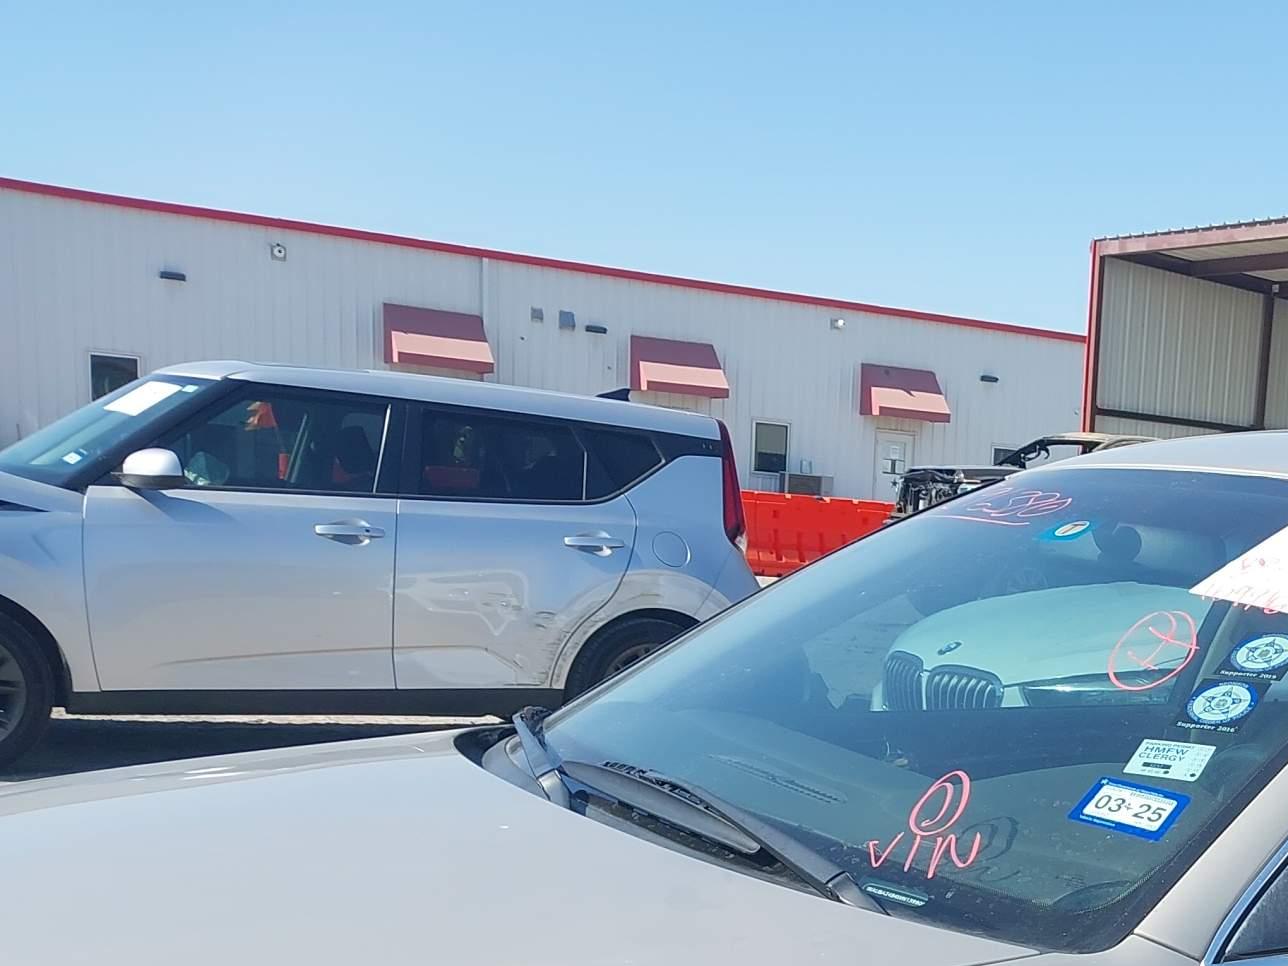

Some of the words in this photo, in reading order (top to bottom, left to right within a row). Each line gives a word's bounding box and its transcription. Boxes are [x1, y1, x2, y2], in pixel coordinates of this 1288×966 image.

[1219, 670, 1258, 679] Supporter
[1176, 720, 1217, 731] Supporter
[1138, 751, 1185, 762] CLERGY
[1094, 794, 1127, 814] 03
[1131, 803, 1168, 823] 25
[866, 829, 983, 880] VIN
